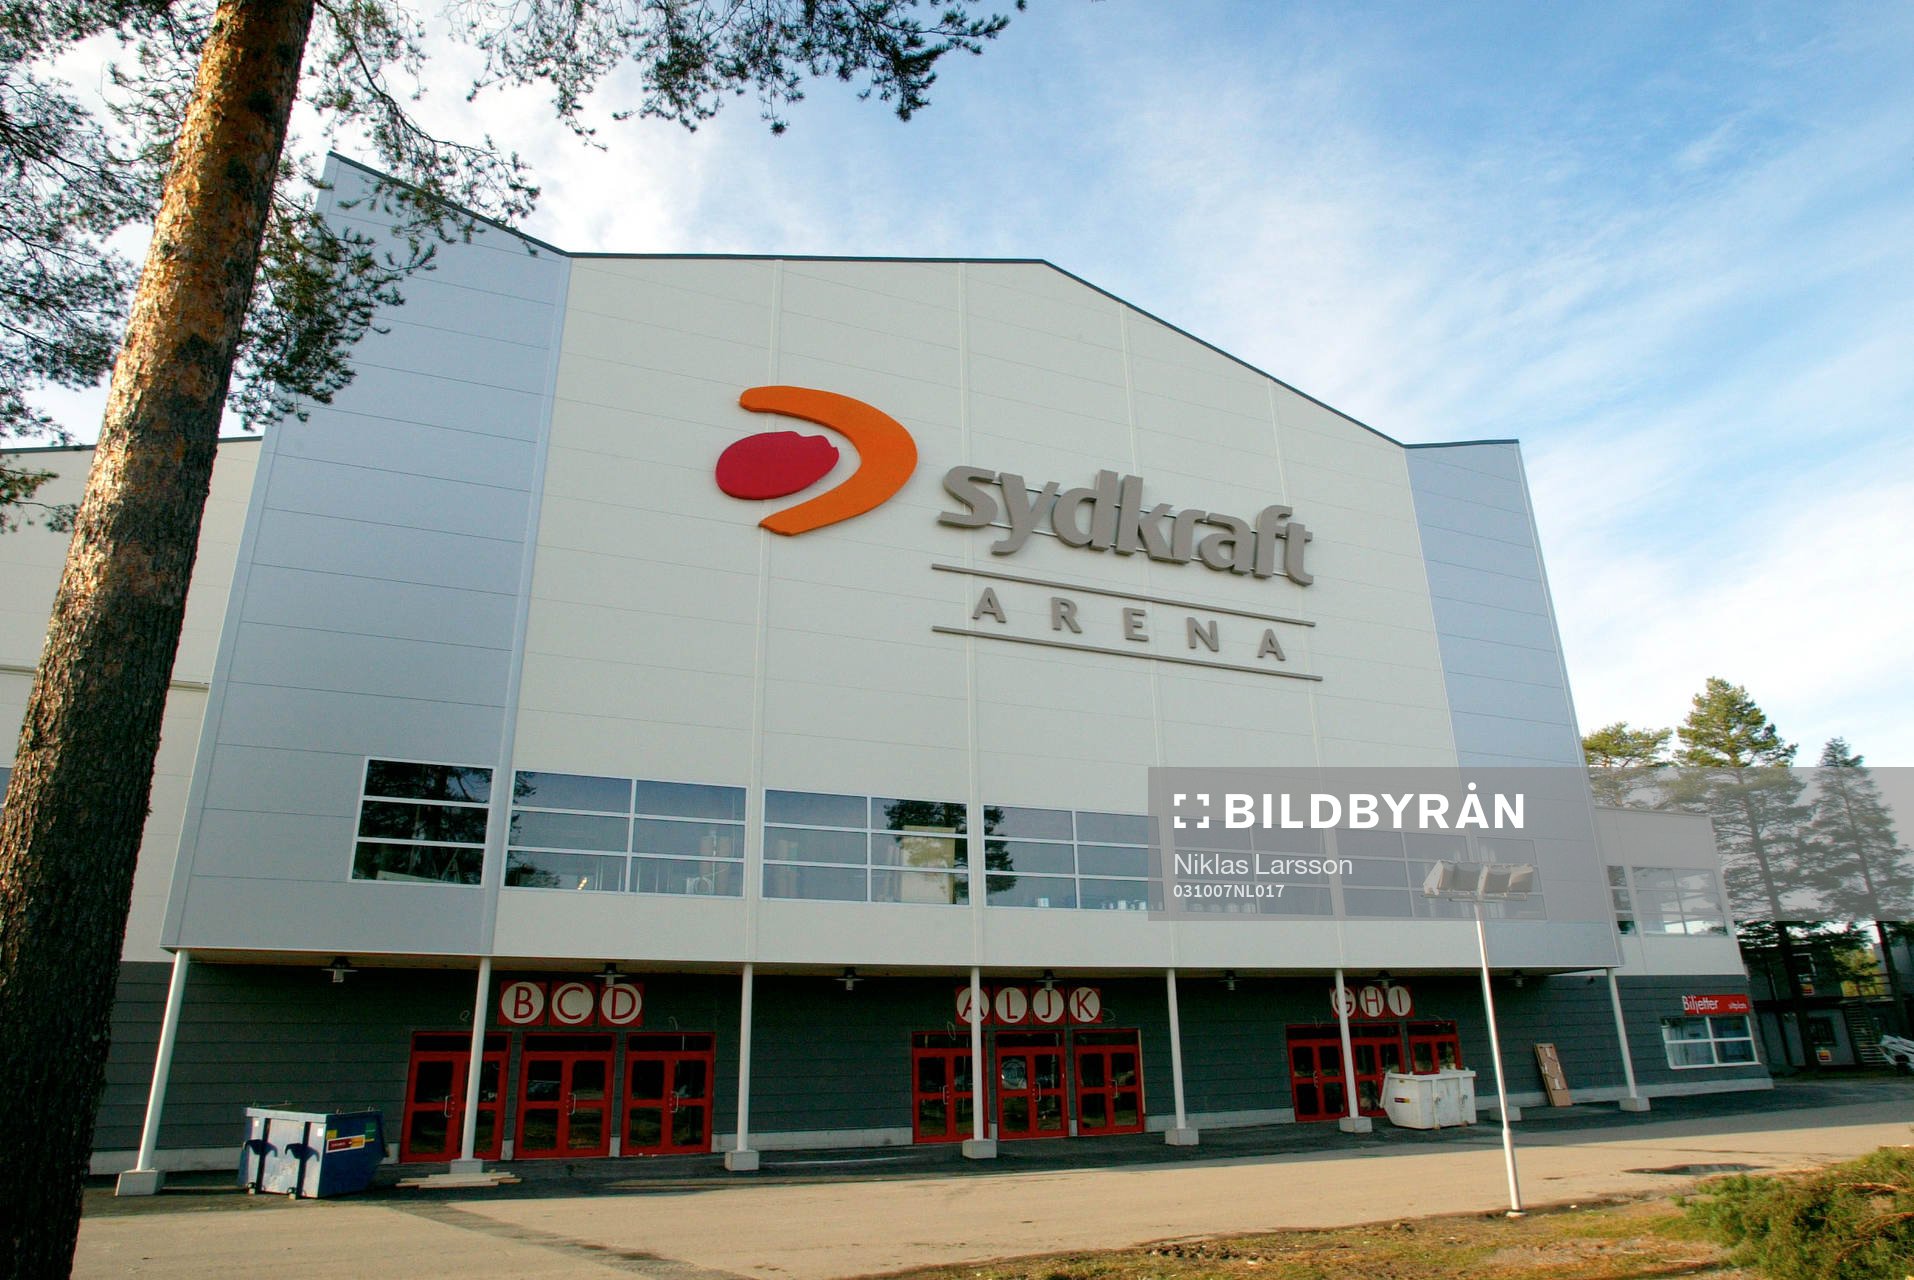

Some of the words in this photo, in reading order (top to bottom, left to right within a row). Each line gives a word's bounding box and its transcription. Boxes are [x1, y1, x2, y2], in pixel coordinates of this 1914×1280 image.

[937, 465, 1314, 587] sydkraft
[972, 586, 1286, 662] ARENA
[1682, 995, 1718, 1014] Biljetter
